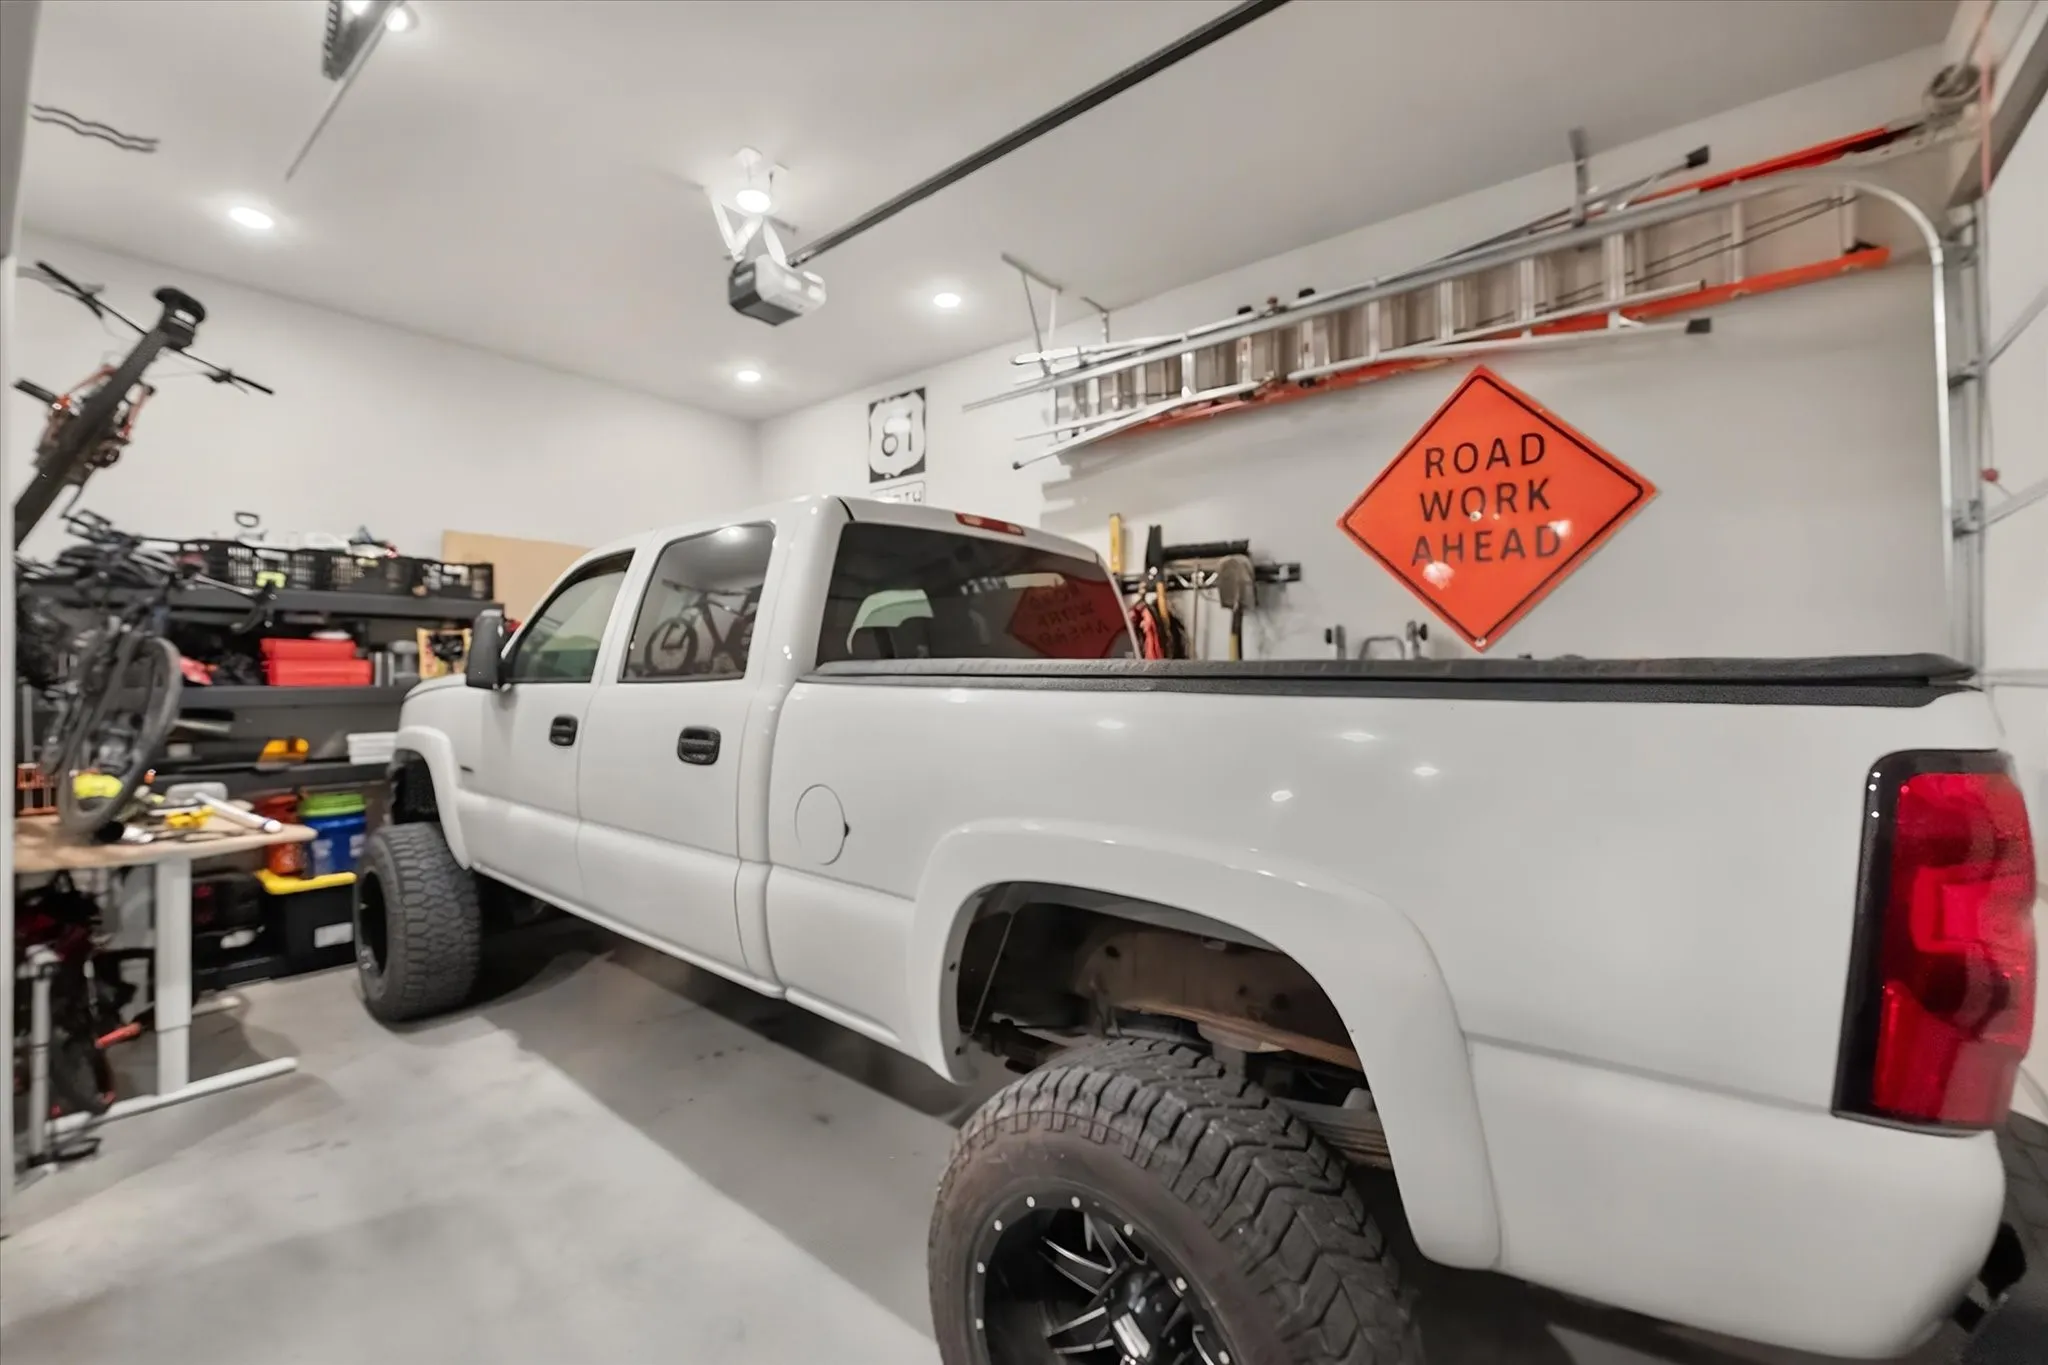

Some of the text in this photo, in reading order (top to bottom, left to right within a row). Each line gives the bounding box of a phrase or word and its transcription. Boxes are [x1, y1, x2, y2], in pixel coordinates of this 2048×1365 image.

[1424, 432, 1546, 479] ROAD
[1420, 477, 1551, 522] WORK
[1411, 524, 1562, 567] AHEAD
